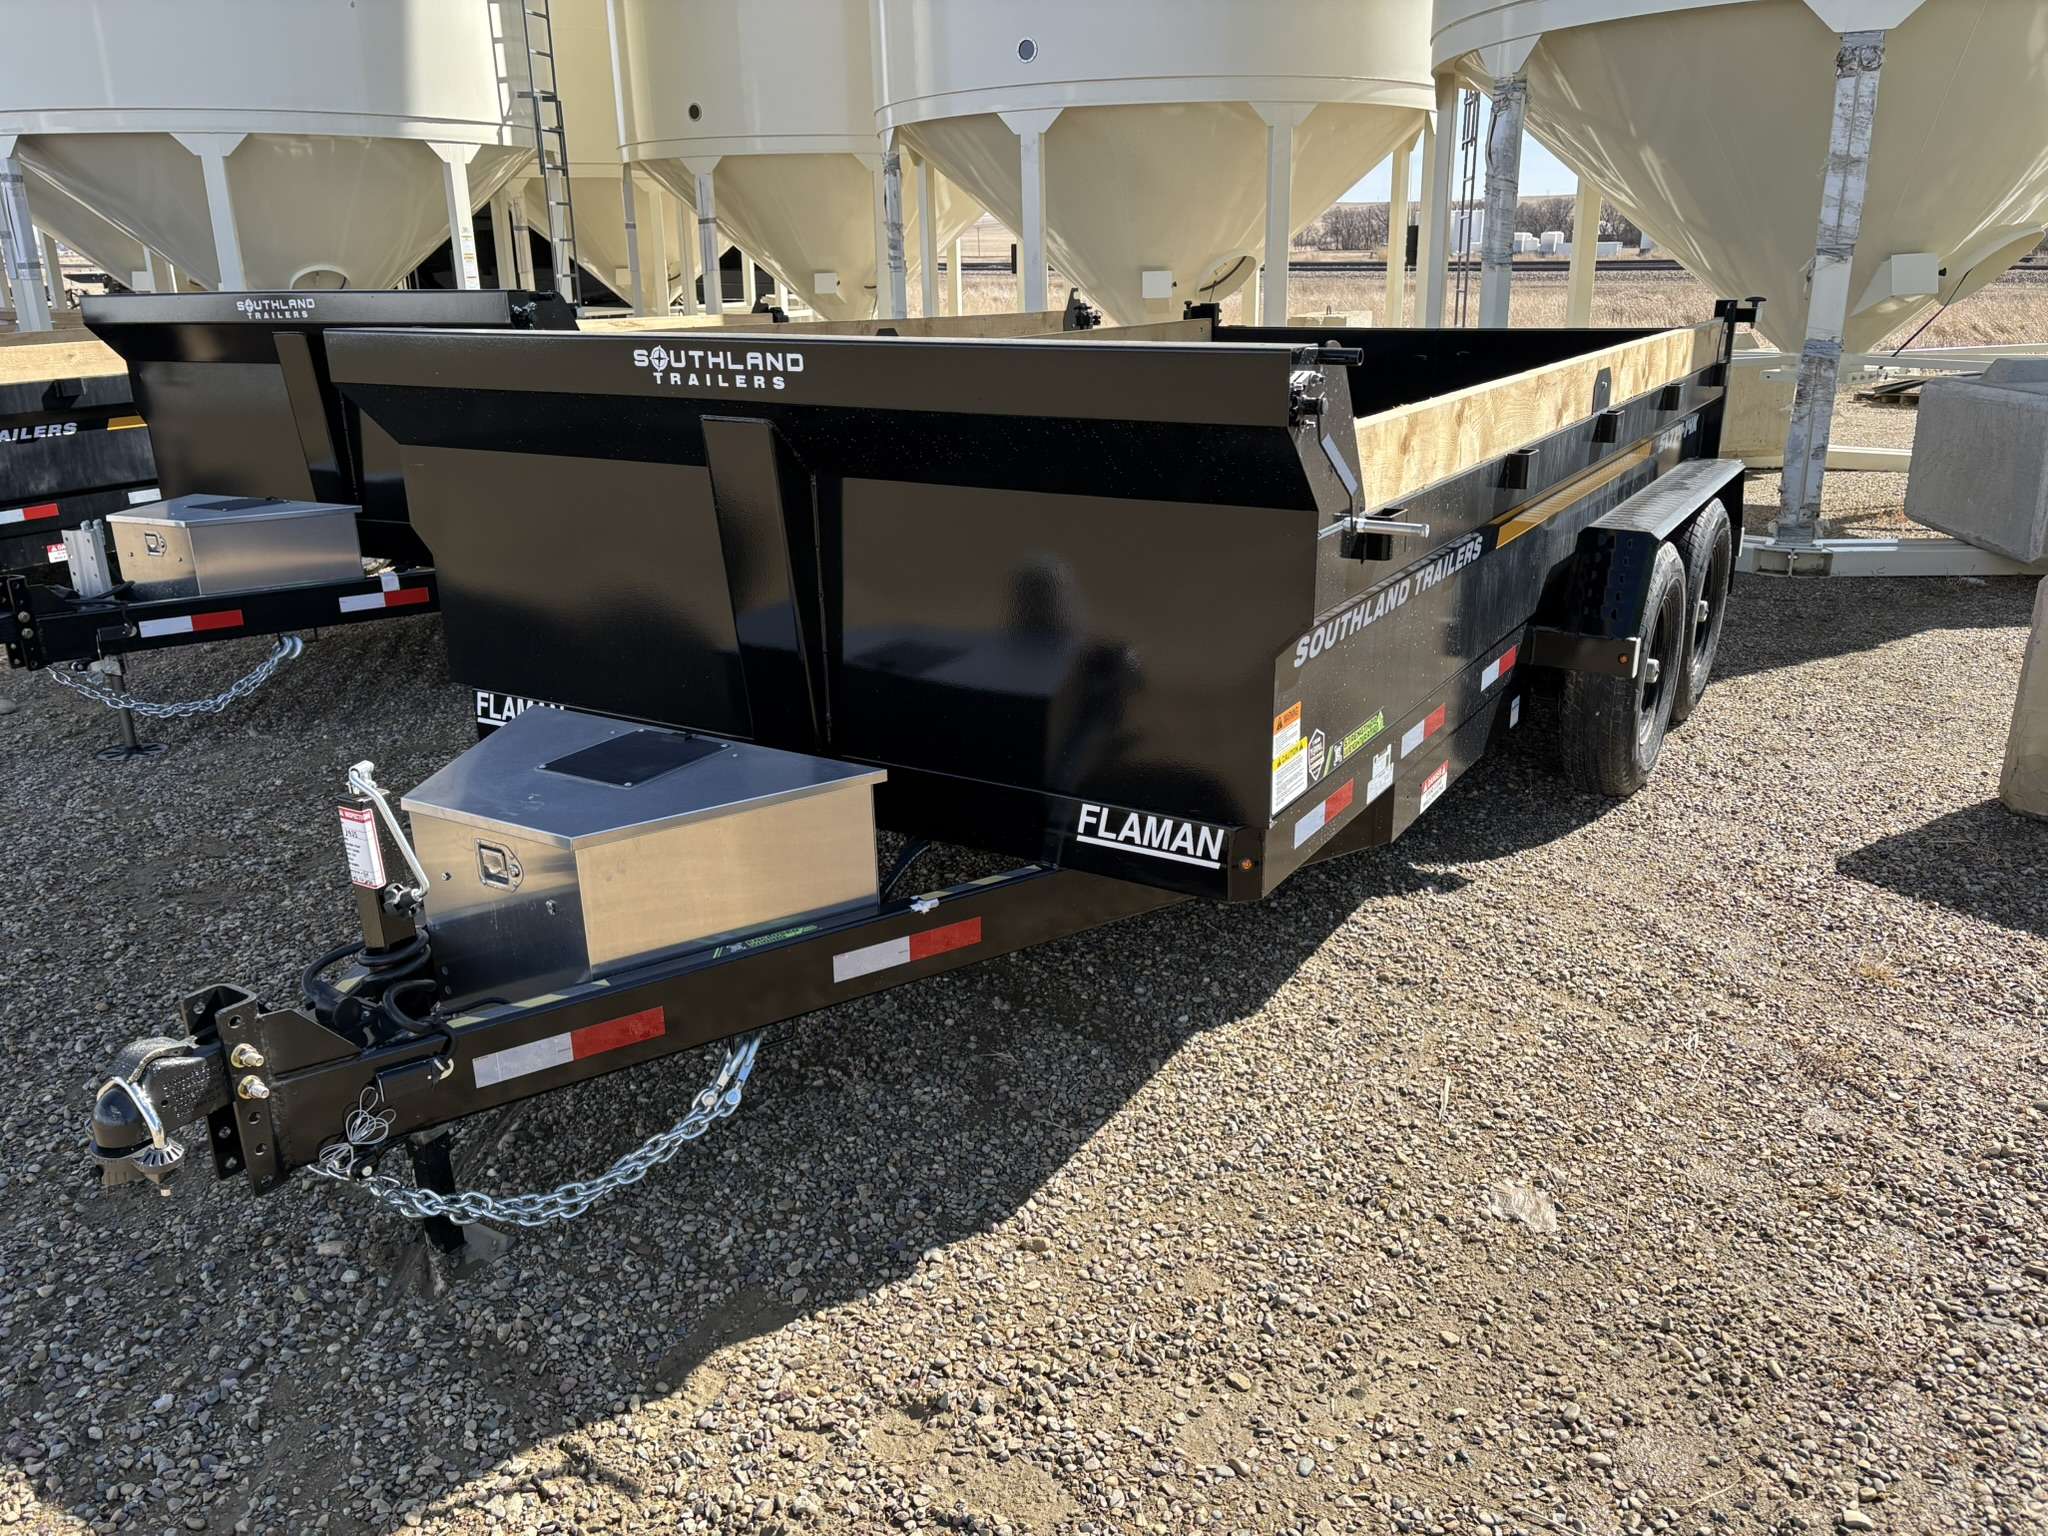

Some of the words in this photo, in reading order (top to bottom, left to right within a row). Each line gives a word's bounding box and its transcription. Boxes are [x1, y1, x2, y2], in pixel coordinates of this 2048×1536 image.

[236, 298, 315, 312] SOUTHLAND
[247, 310, 308, 320] TRAILERS
[632, 345, 805, 372] SOUTHLAND
[653, 372, 786, 390] TRAILERS
[1293, 578, 1411, 669] SOUTHLAND
[1414, 535, 1484, 597] TRAILERS
[476, 691, 565, 721] FLAM
[1077, 803, 1225, 861] FLAMAN
